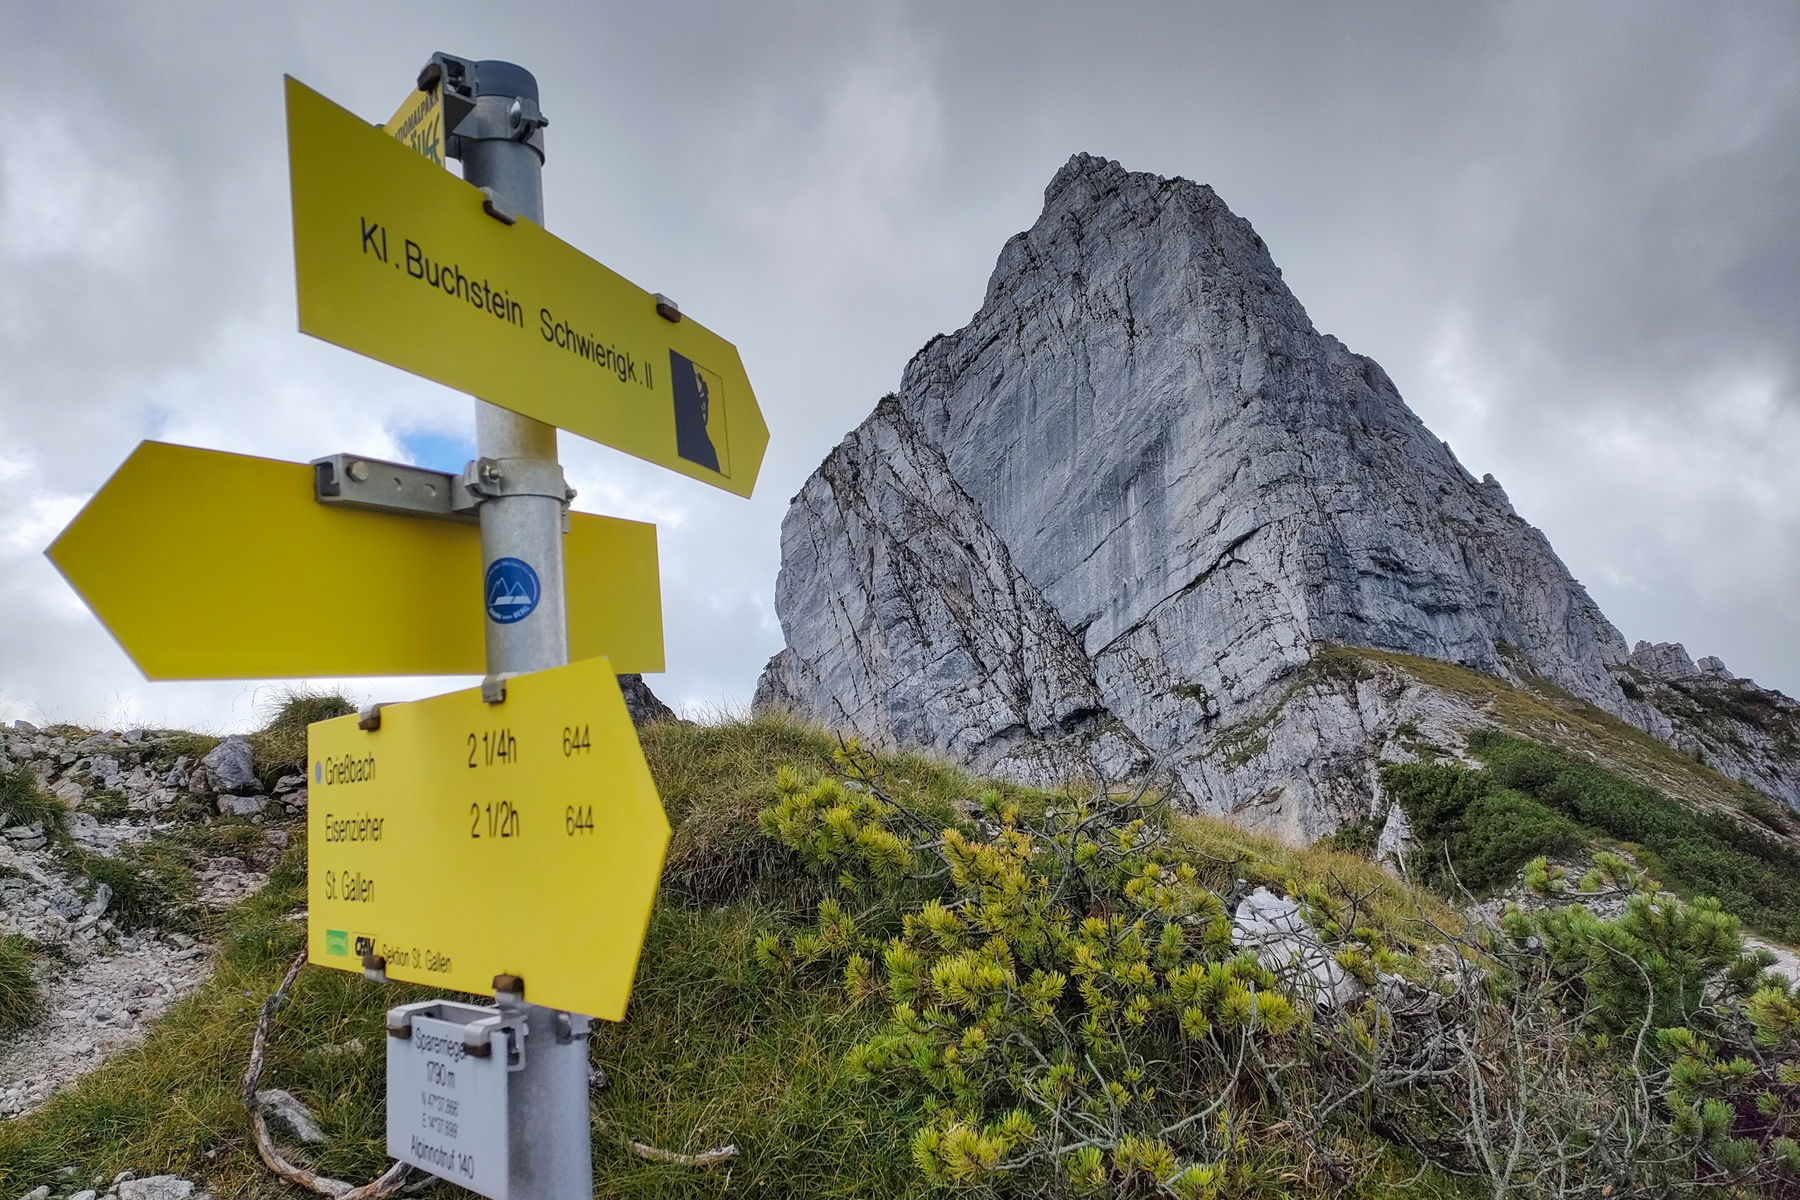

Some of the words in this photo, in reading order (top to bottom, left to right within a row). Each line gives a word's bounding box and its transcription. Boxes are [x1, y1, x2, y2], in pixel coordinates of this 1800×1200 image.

[405, 238, 524, 328] Buchstein
[540, 308, 643, 383] Schwierigk.
[325, 752, 376, 785] Grießbach
[467, 732, 478, 768] 2
[482, 728, 518, 766] 1/4h
[562, 724, 591, 757] 644
[325, 812, 385, 842] Eisenzieher
[470, 802, 480, 838] 2
[486, 800, 520, 838] 1/2h
[565, 804, 594, 836] 644
[325, 869, 338, 900] St.
[341, 870, 375, 902] Gallen
[425, 948, 452, 973] Gallen
[410, 1133, 456, 1172] Alpinnotruf
[457, 1152, 475, 1180] 140
